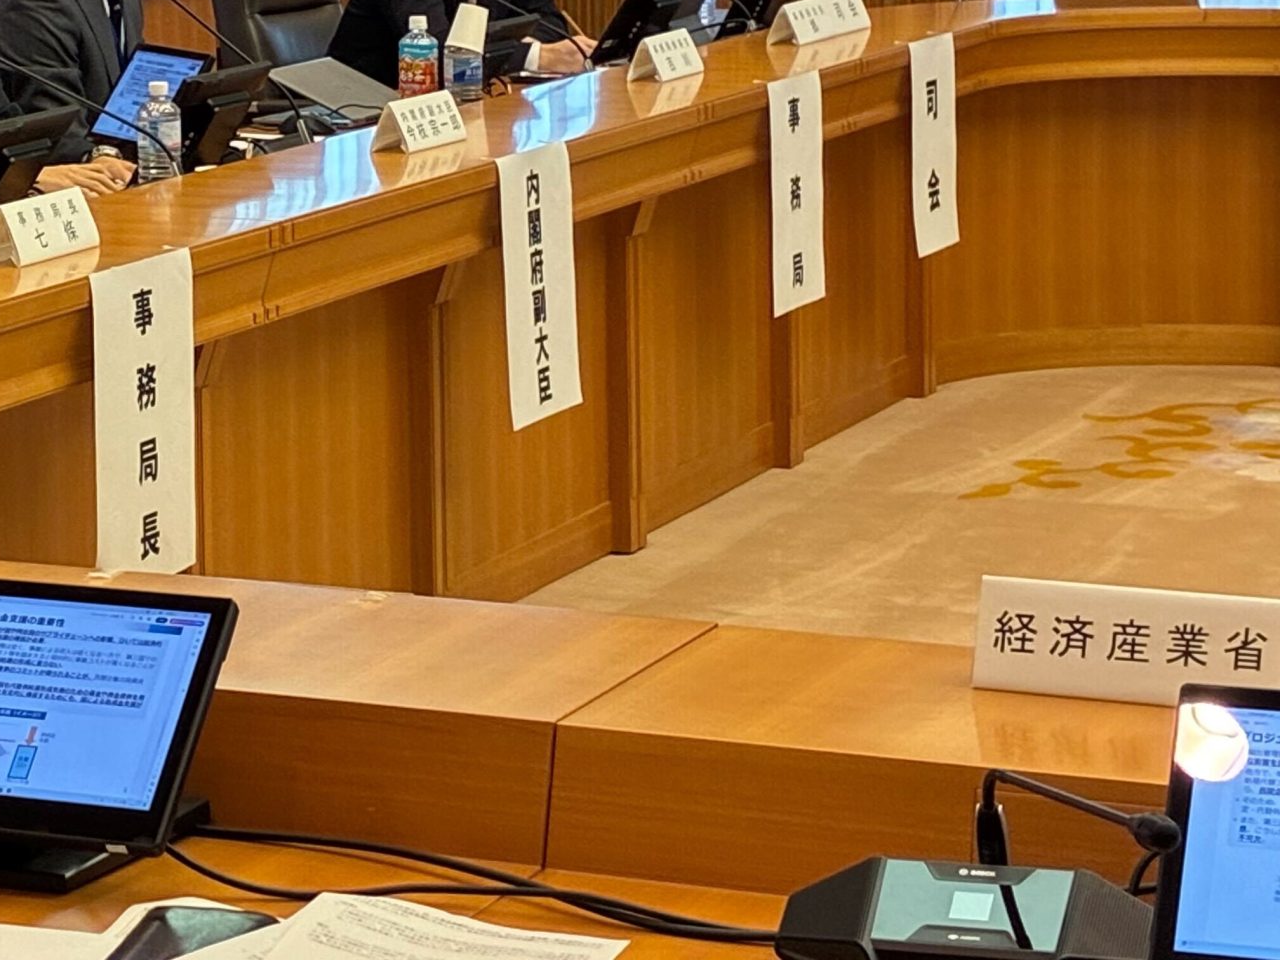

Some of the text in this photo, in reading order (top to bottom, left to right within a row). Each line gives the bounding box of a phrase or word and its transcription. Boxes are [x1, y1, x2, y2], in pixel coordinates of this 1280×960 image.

[788, 97, 804, 288] 事務局
[926, 79, 940, 212] 司会
[526, 169, 553, 405] 内閣府副大臣
[132, 288, 161, 561] 事務局長
[992, 610, 1269, 672] 経済産業省
